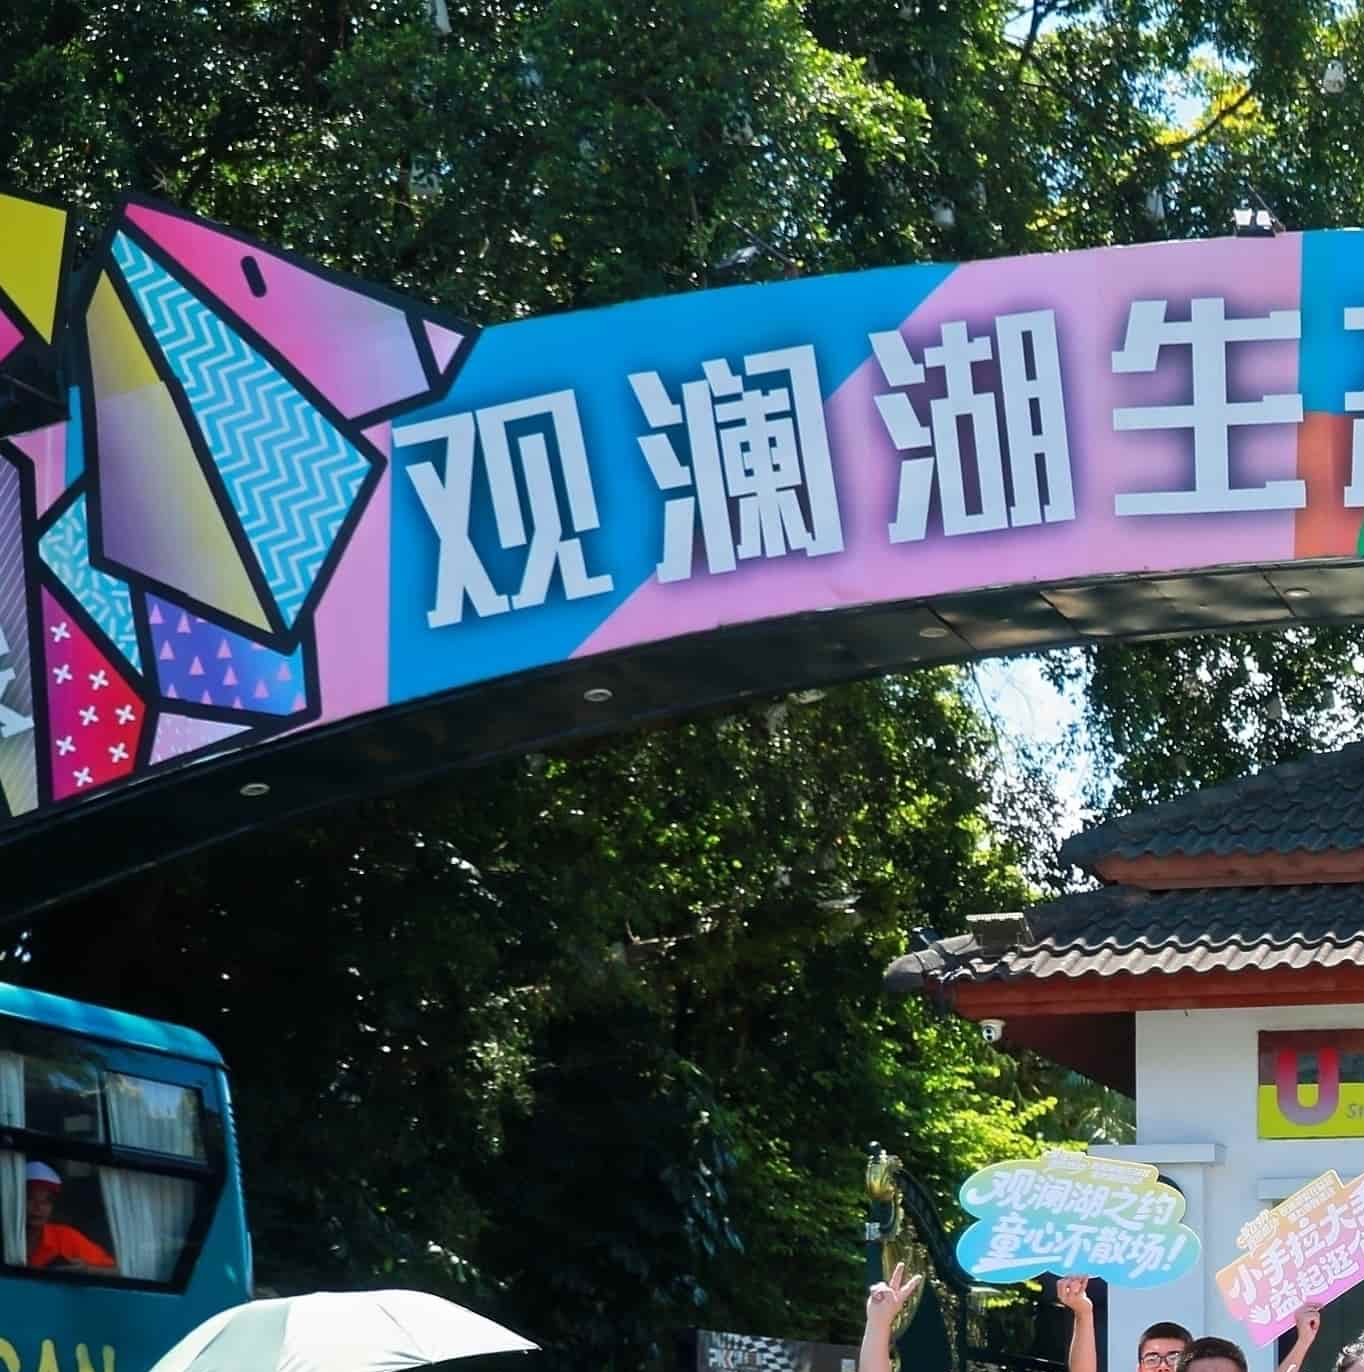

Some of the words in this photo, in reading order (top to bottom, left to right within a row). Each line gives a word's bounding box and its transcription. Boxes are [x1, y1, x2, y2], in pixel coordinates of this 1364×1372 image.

[967, 1168, 1176, 1231] 观澜湖之约
